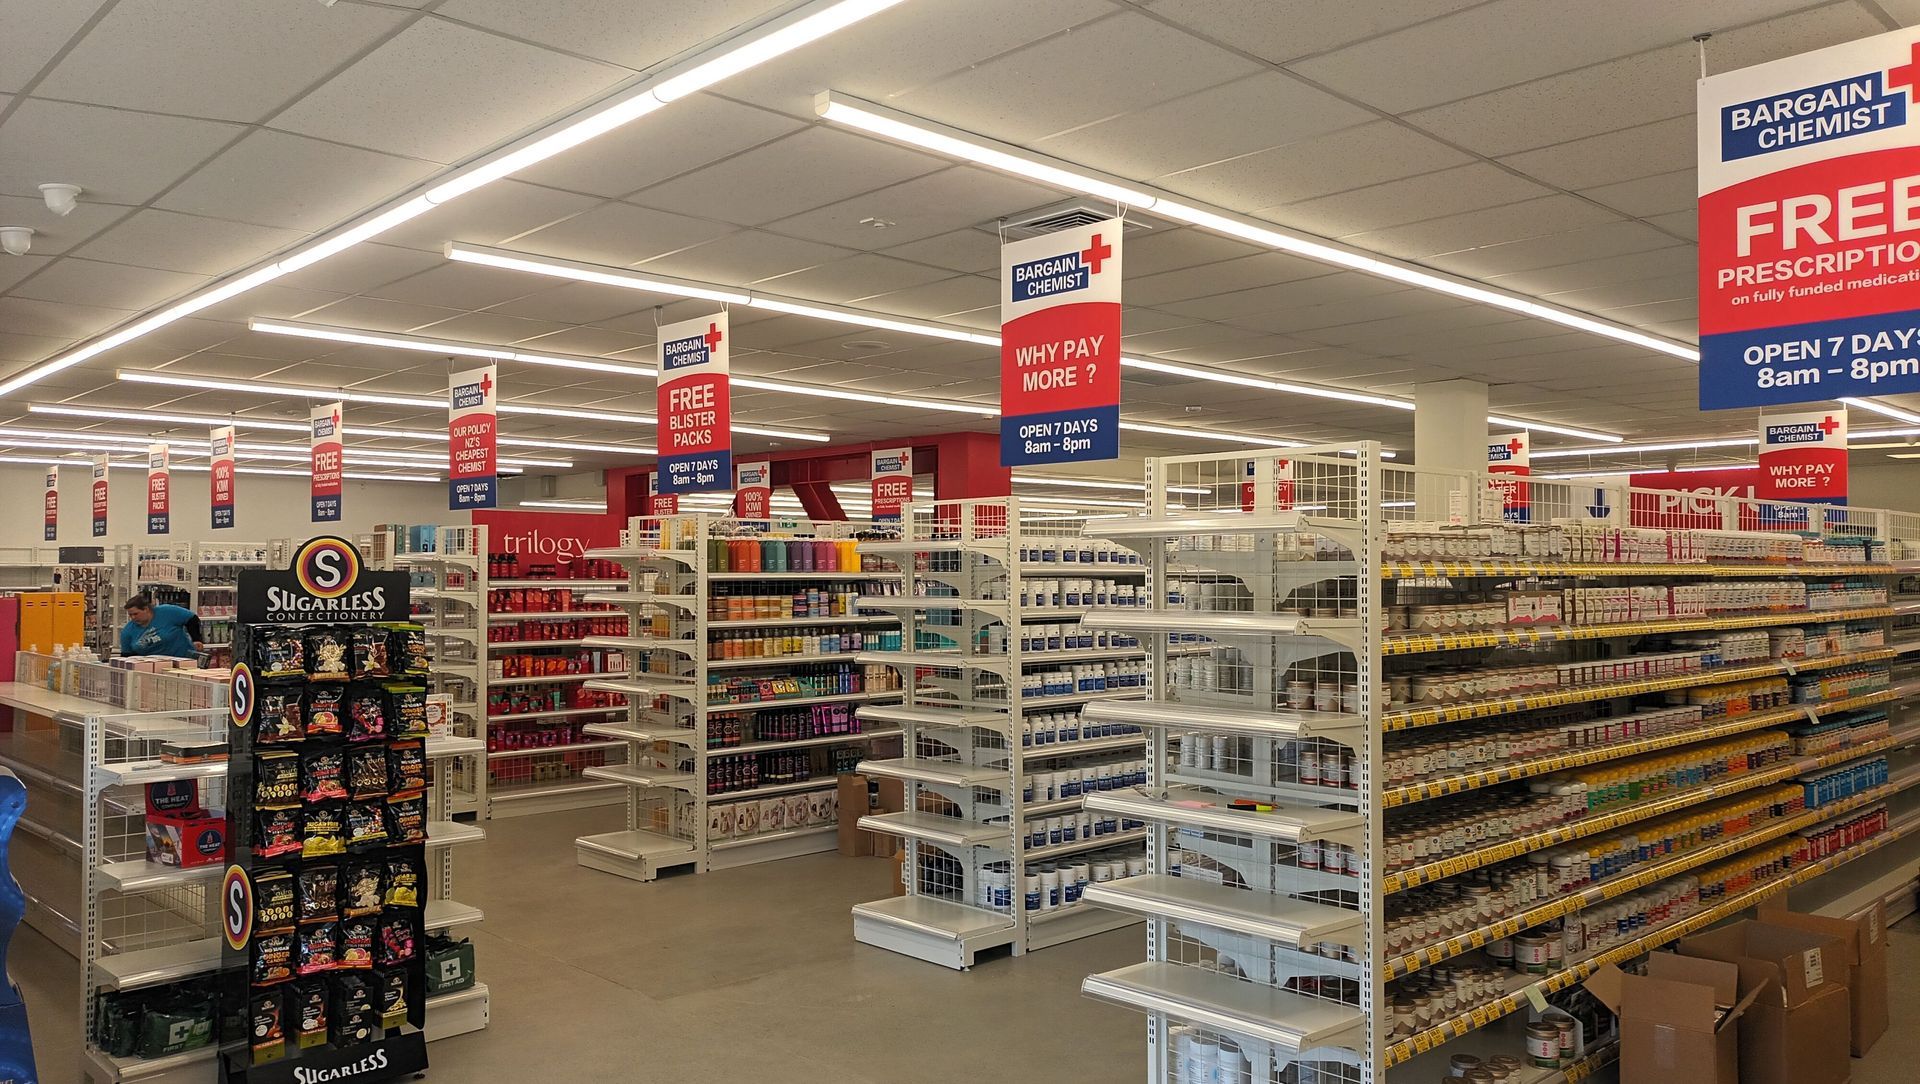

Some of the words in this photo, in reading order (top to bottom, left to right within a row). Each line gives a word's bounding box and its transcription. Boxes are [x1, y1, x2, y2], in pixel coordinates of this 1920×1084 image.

[1731, 79, 1872, 131] BARGAIN
[1758, 101, 1891, 150] CHEMIST
[1016, 256, 1076, 283] BARGAIN
[1027, 271, 1083, 296] CHEMIST
[1731, 292, 1750, 305] on
[1753, 285, 1785, 303] fully
[1788, 280, 1844, 298] funded
[665, 338, 702, 356] BARGAIN
[1015, 342, 1060, 367] WHY
[1063, 334, 1105, 361] PAY
[1743, 338, 1820, 366] OPEN
[1827, 336, 1845, 357] 7
[1851, 327, 1920, 355] DAY
[672, 350, 706, 367] CHEMIST
[1023, 366, 1077, 392] MORE
[1085, 363, 1097, 384] ?
[1757, 367, 1820, 389] 8am
[1850, 358, 1919, 384] 8pm
[454, 384, 479, 399] BARGAIN
[669, 383, 715, 413] FREE
[458, 394, 482, 408] CHEMIST
[669, 411, 716, 430] BLISTER
[453, 424, 467, 438] OUR
[467, 422, 492, 437] POLICY
[1019, 422, 1052, 439] OPEN
[1053, 422, 1062, 436] 7
[1063, 418, 1098, 435] DAYS
[1769, 425, 1814, 435] BARGAIN
[464, 436, 481, 449] NZ'S
[673, 429, 712, 448] PACKS
[1024, 439, 1051, 454] 8am
[1062, 436, 1091, 453] 8pm
[1778, 433, 1820, 442] CHEMIST
[315, 451, 338, 472] FREE
[455, 448, 489, 462] CHEAPEST
[876, 457, 899, 466] BARGAIN
[215, 466, 230, 479] 100%
[458, 461, 487, 474] CHEMIST
[669, 461, 690, 474] OPEN
[691, 461, 696, 472] 7
[696, 459, 718, 471] DAYS
[1769, 465, 1803, 476] WHY
[1805, 463, 1835, 475] PAY
[313, 471, 340, 482] PRESCRIPTIONS
[672, 474, 690, 486] 8am
[696, 472, 715, 485] 8pm
[1775, 476, 1817, 489] MORE
[1822, 476, 1831, 487] ?
[151, 478, 166, 491] FREE
[456, 484, 470, 494] OPEN
[470, 484, 474, 492] 7
[474, 482, 489, 492] DAYS
[877, 482, 907, 497] FREE
[458, 494, 470, 503] 8am
[474, 493, 486, 504] 8pm
[653, 497, 673, 508] FREE
[744, 491, 763, 502] 100%
[874, 496, 911, 505] PRESCRIPTIONS
[1661, 486, 1739, 515] PICK
[745, 501, 762, 512] KIWI
[503, 528, 590, 564] trilogy
[315, 549, 341, 589] S
[266, 586, 386, 613] SUGARLESS
[266, 611, 385, 622] CONFECTIONERY
[235, 674, 247, 716] S
[170, 794, 189, 803] HEAT
[229, 879, 244, 935] S
[263, 951, 290, 960] GINGER
[438, 980, 455, 989] FIRST
[454, 977, 465, 985] AID
[293, 1048, 388, 1084] SUGARLESS
